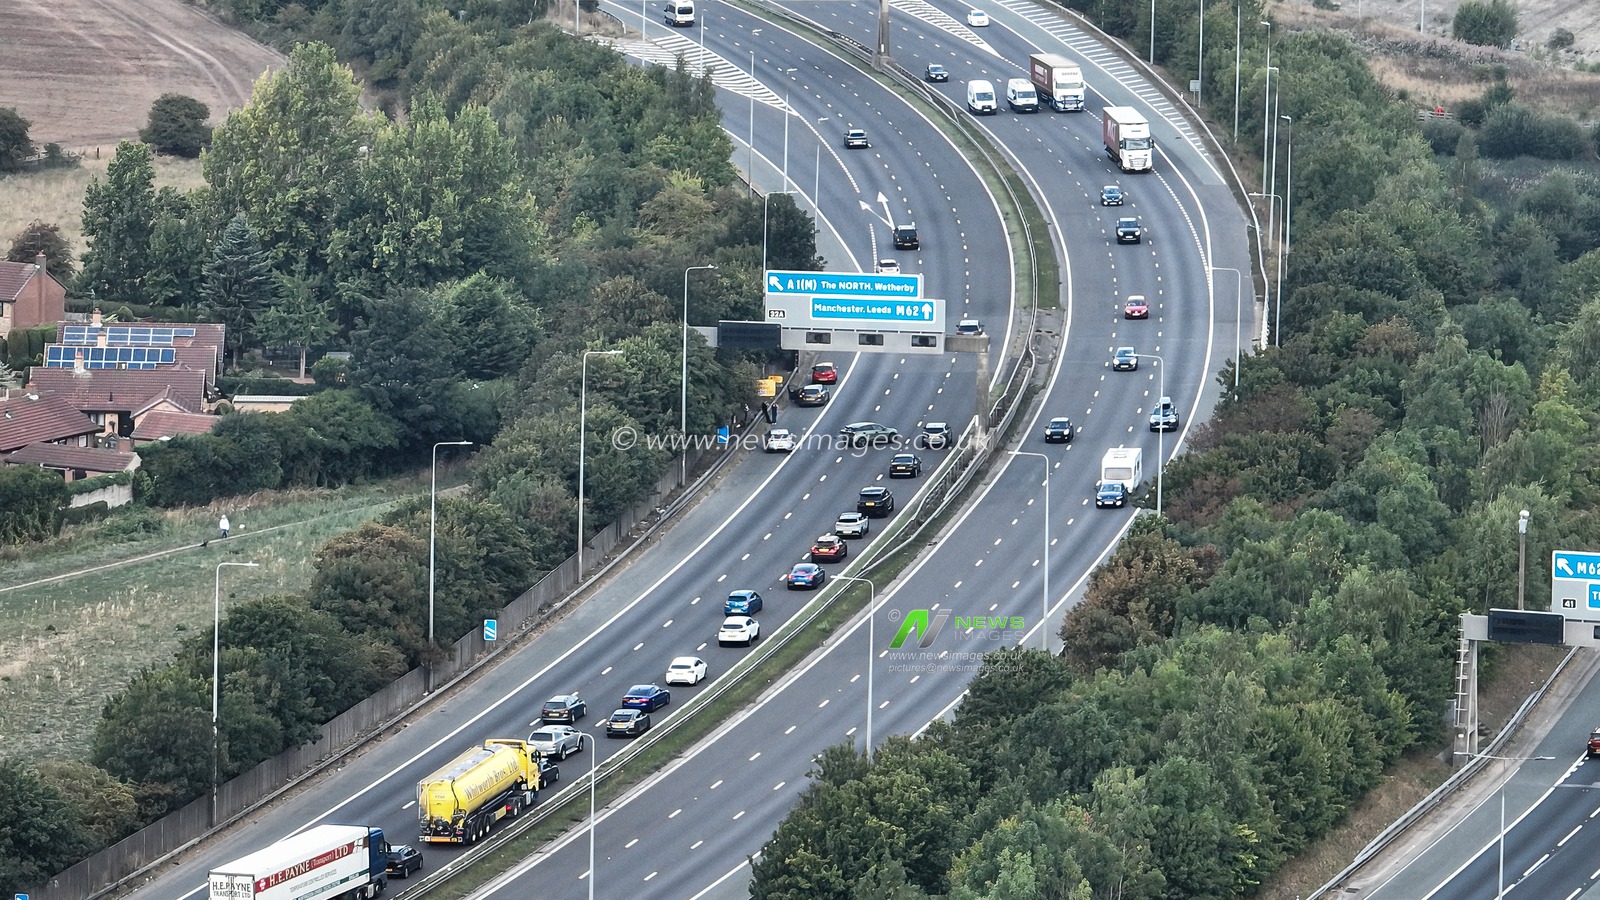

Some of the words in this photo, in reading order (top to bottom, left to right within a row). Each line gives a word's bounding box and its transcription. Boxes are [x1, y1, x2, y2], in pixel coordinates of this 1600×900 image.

[821, 280, 837, 290] The
[874, 282, 915, 293] Wetherby
[866, 304, 892, 314] Leeds
[895, 304, 919, 317] M62
[1564, 600, 1574, 608] 41
[334, 844, 349, 859] LTD
[213, 890, 241, 898] TRANSPORT
